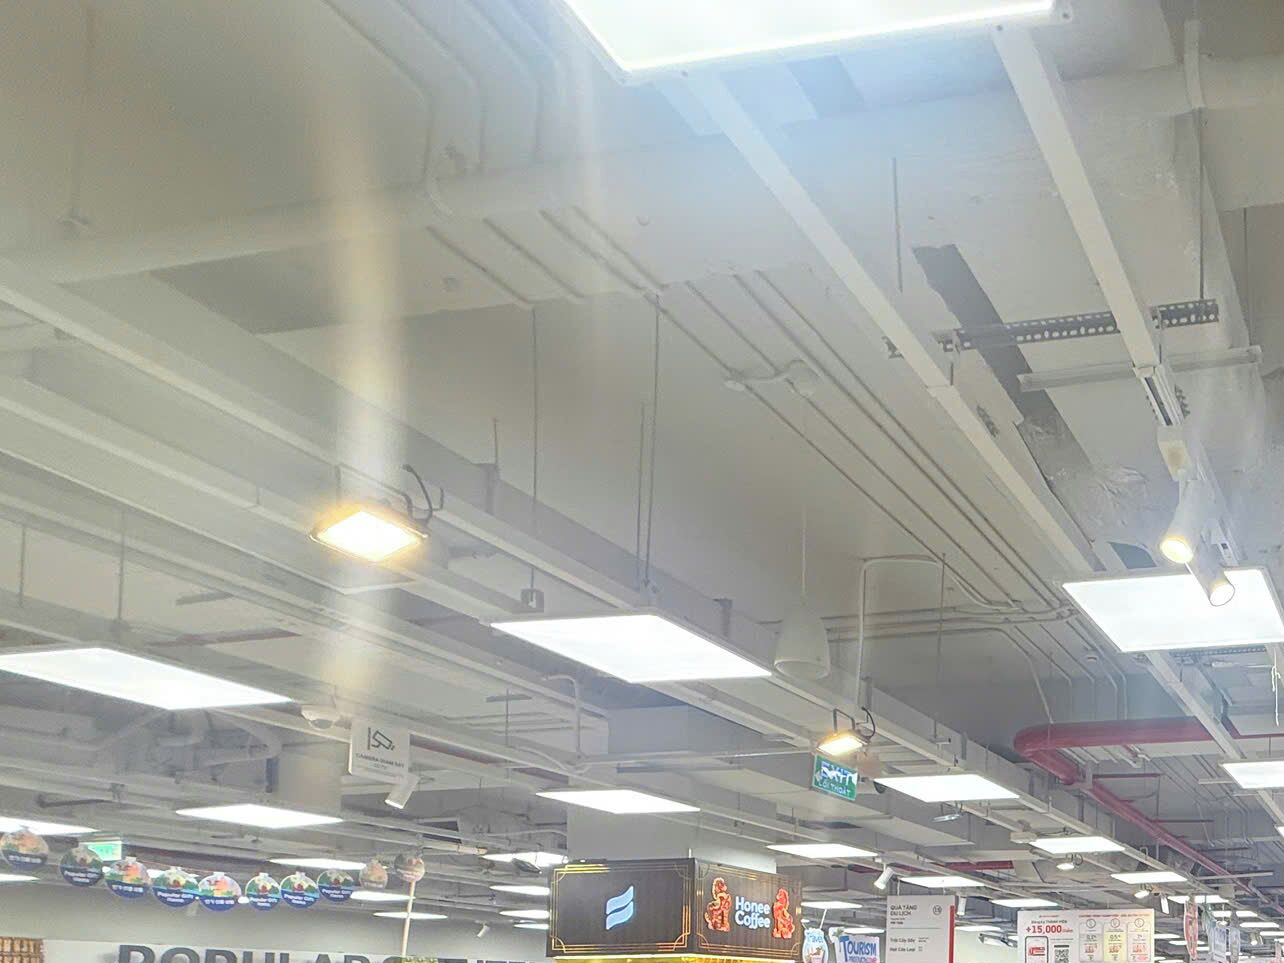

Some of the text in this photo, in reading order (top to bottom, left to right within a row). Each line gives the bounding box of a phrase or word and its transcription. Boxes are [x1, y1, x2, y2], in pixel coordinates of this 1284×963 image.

[735, 896, 770, 915] Honee
[734, 911, 771, 931] Coffee
[839, 935, 877, 963] TOURISM
